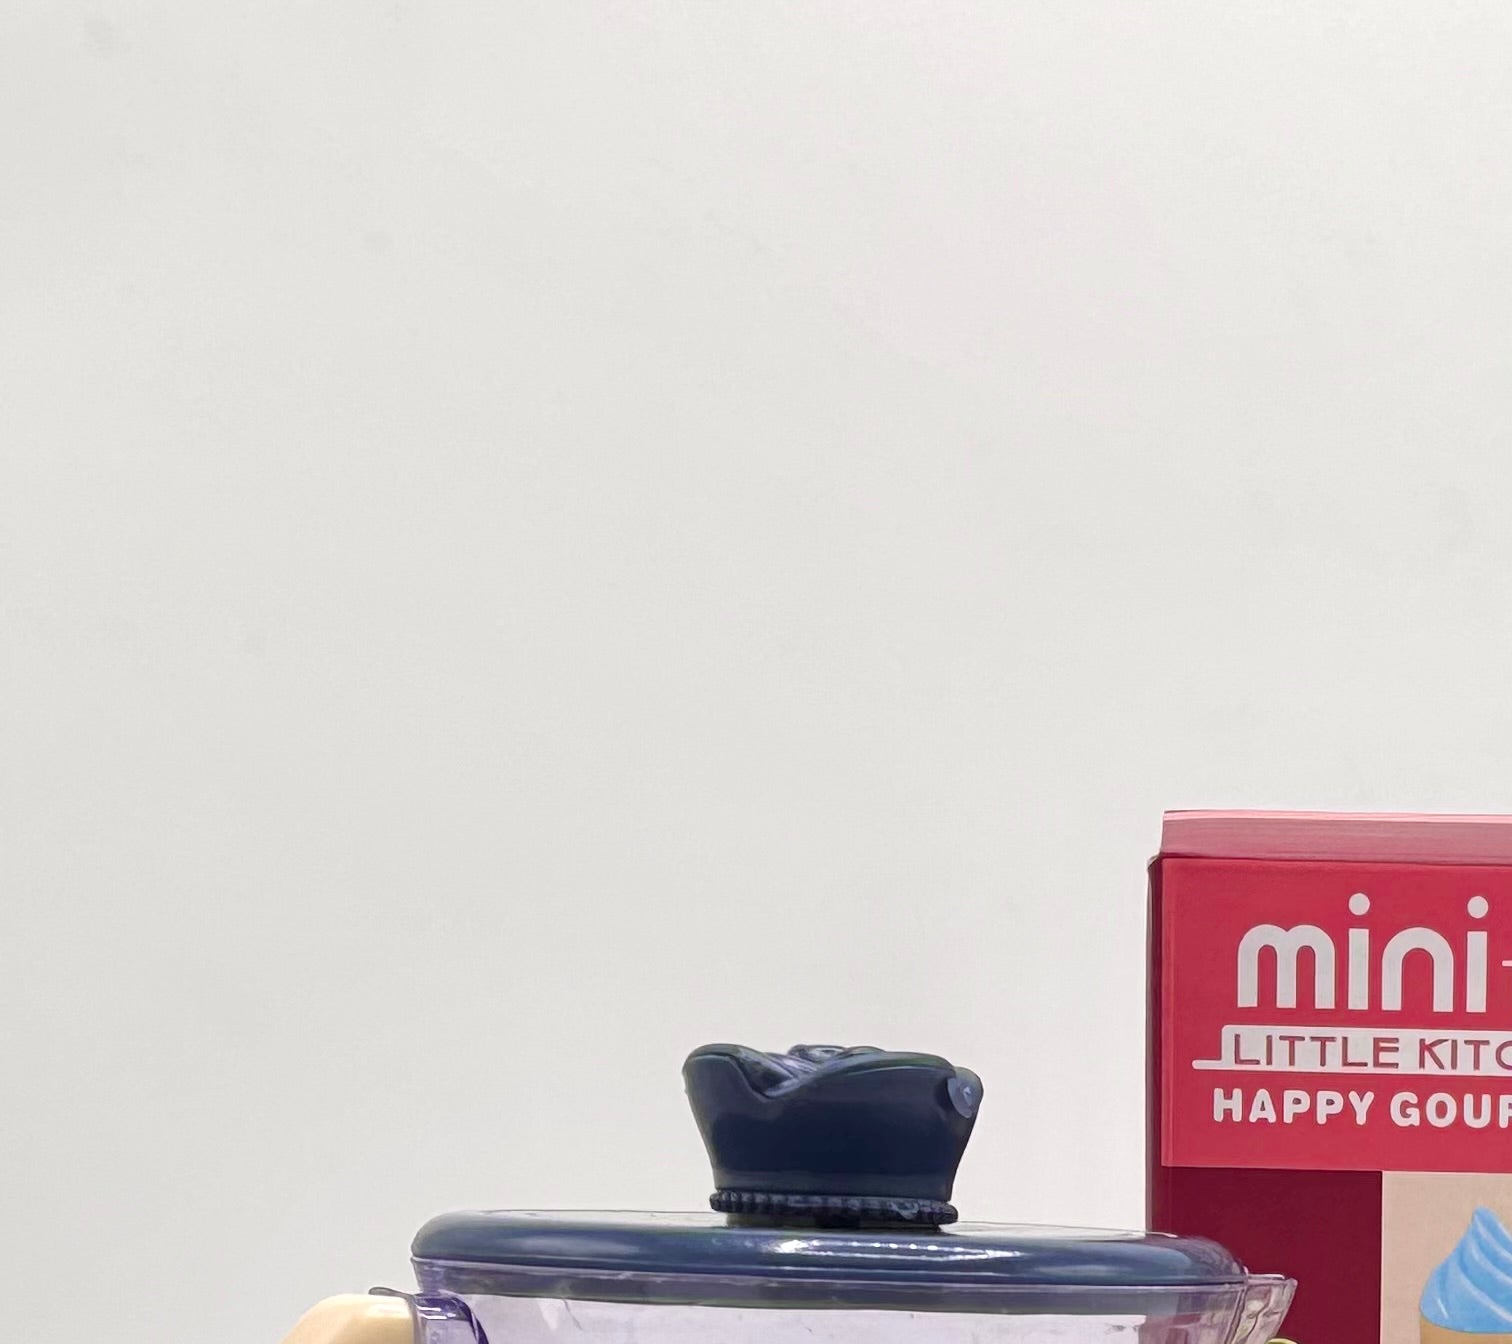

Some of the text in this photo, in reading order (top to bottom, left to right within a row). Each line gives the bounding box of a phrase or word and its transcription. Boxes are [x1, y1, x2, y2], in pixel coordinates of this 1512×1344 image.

[1237, 892, 1489, 1013] mini
[1234, 1033, 1399, 1069] LITTLE
[1213, 1087, 1374, 1125] HAPPY
